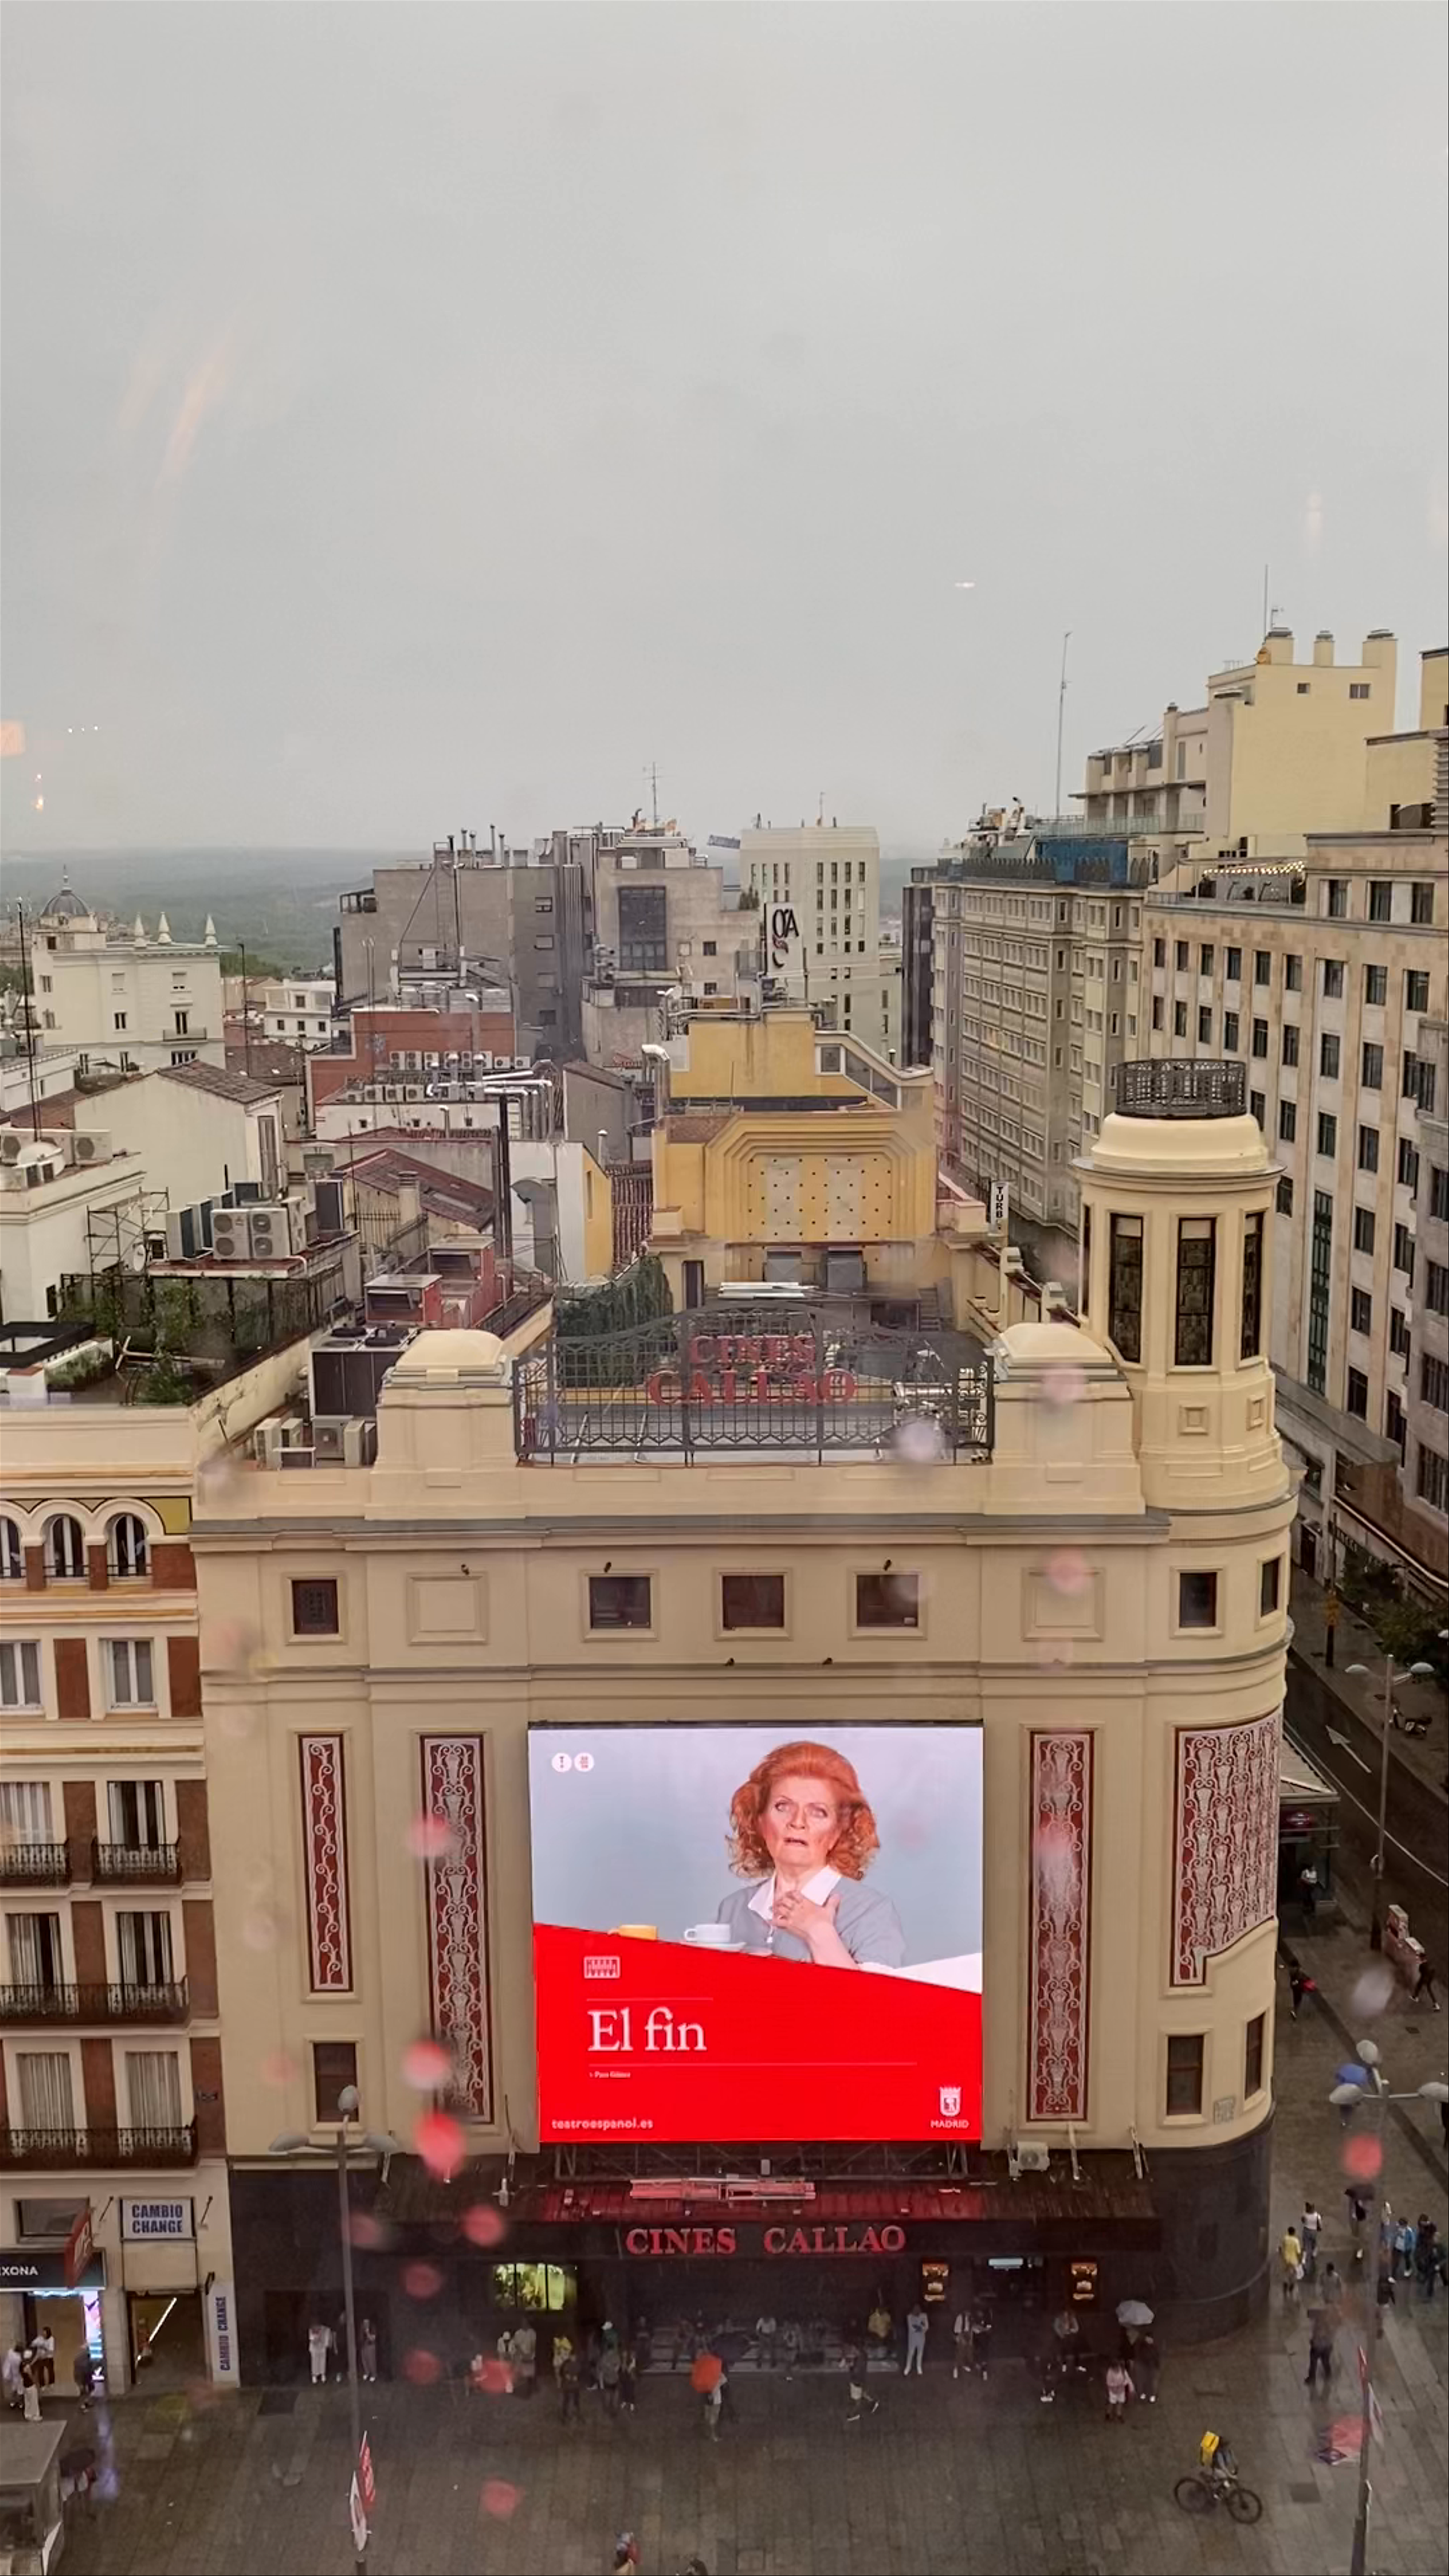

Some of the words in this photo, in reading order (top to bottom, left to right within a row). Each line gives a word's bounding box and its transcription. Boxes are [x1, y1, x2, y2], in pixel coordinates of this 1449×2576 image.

[690, 1336, 817, 1364] CINES
[648, 1368, 857, 1407] CALLAO
[588, 2008, 633, 2052] El
[645, 2007, 707, 2052] fin
[930, 2119, 970, 2128] MADRID
[132, 2204, 183, 2218] CAMBIO
[132, 2220, 183, 2234] CHANGE
[626, 2228, 737, 2255] CINES
[763, 2225, 906, 2254] CALLAO
[0, 2266, 38, 2276] XONA
[215, 2296, 228, 2331] CHANGE
